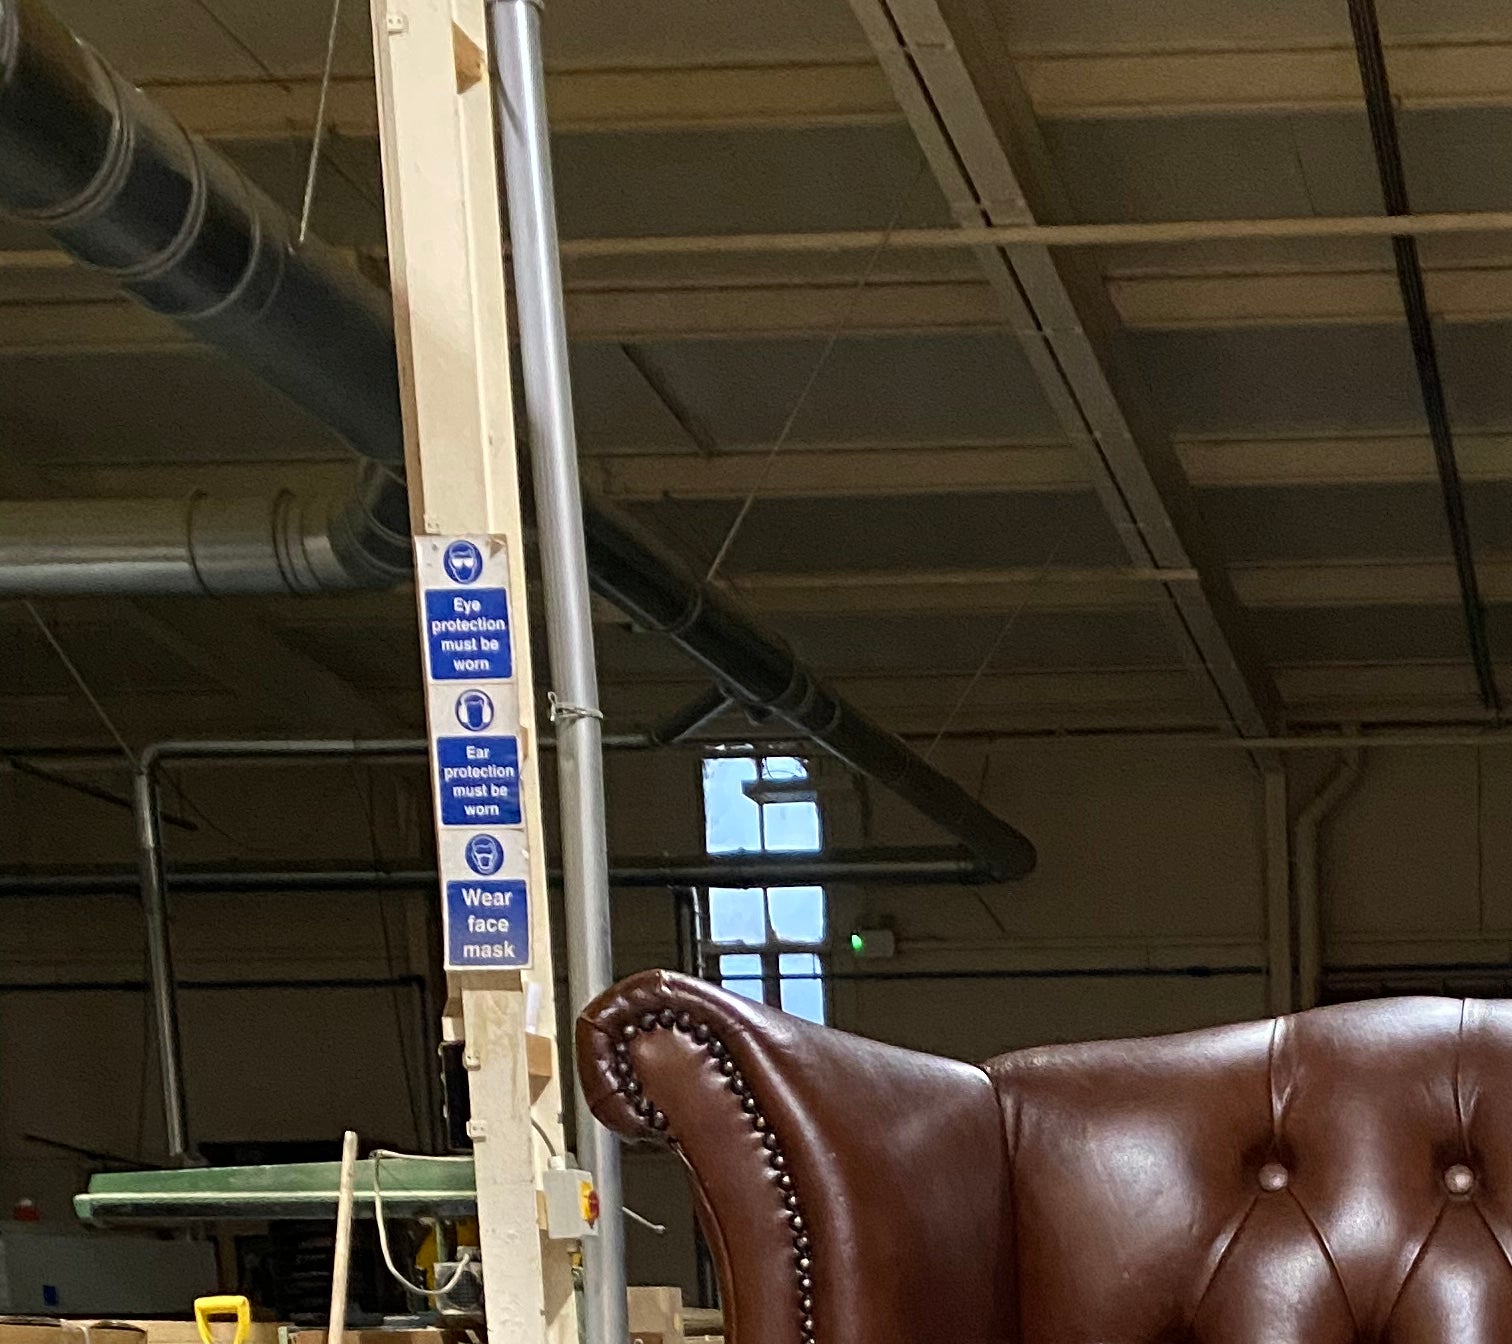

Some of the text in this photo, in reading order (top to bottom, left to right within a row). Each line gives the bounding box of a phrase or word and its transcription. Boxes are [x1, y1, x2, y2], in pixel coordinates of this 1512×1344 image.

[453, 596, 481, 616] Eye
[431, 616, 506, 635] protection
[441, 636, 499, 652] must be
[453, 658, 490, 671] worn
[465, 745, 490, 759] Ear
[443, 764, 515, 782] protection
[452, 783, 508, 798] must be
[463, 804, 500, 816] worn
[461, 887, 513, 907] Wear
[467, 914, 510, 933] face
[463, 940, 516, 958] mask
